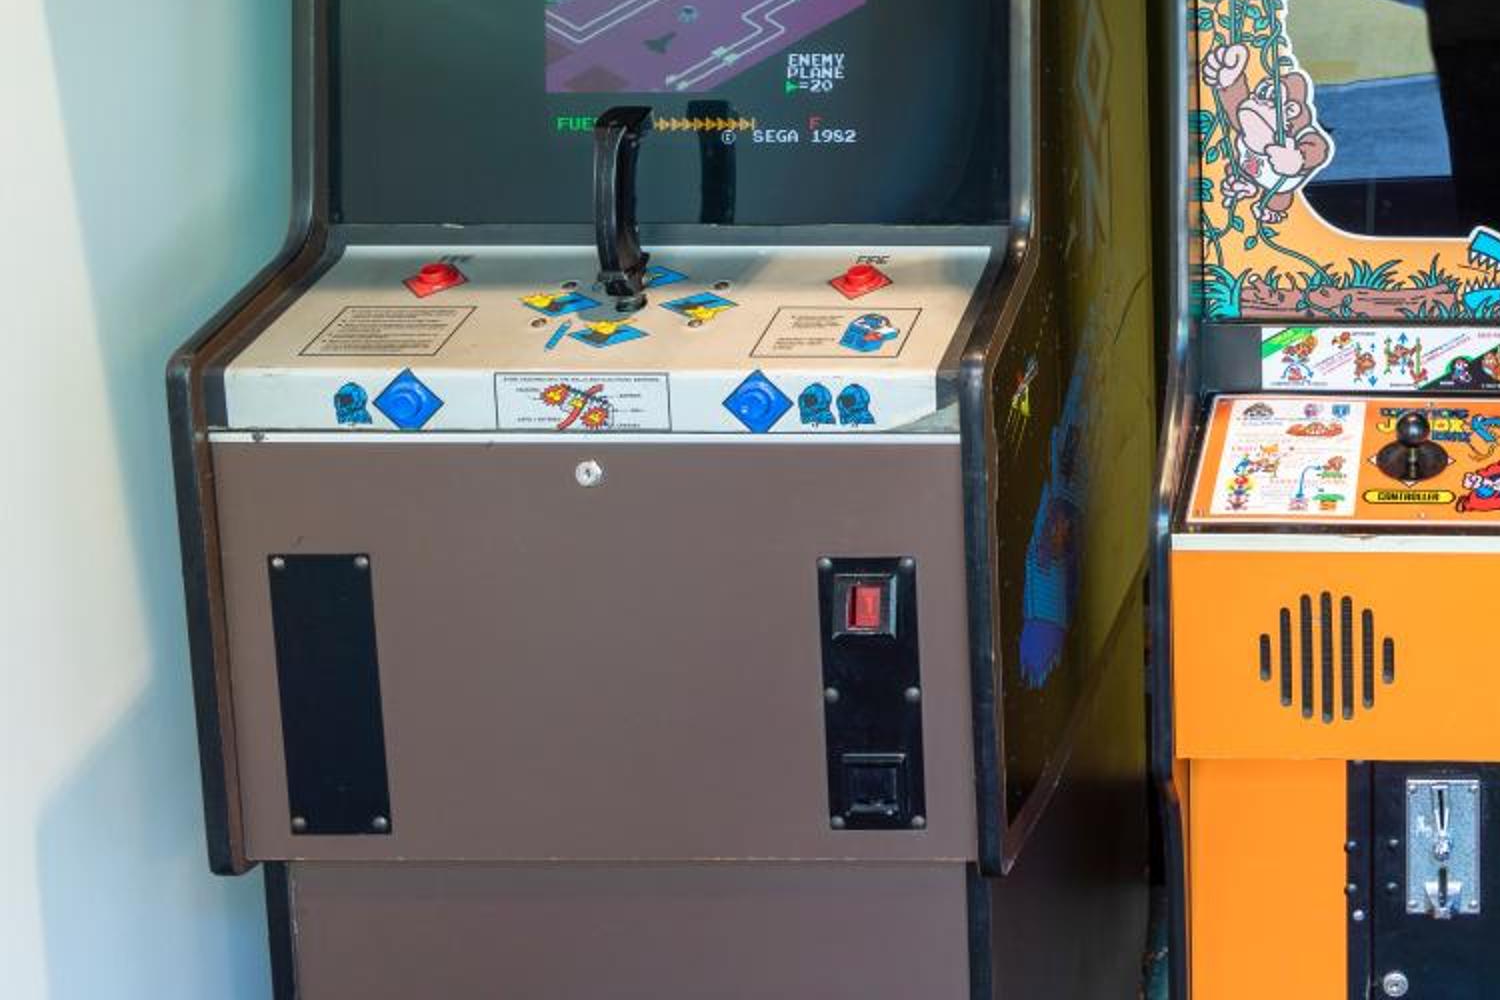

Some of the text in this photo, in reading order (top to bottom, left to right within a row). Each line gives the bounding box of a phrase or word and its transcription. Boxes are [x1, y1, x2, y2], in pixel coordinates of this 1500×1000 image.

[787, 53, 844, 67] ENEMY
[787, 66, 844, 80] PLANE
[556, 117, 599, 131] FUE
[753, 129, 799, 143] SEGA
[811, 129, 857, 143] 1982
